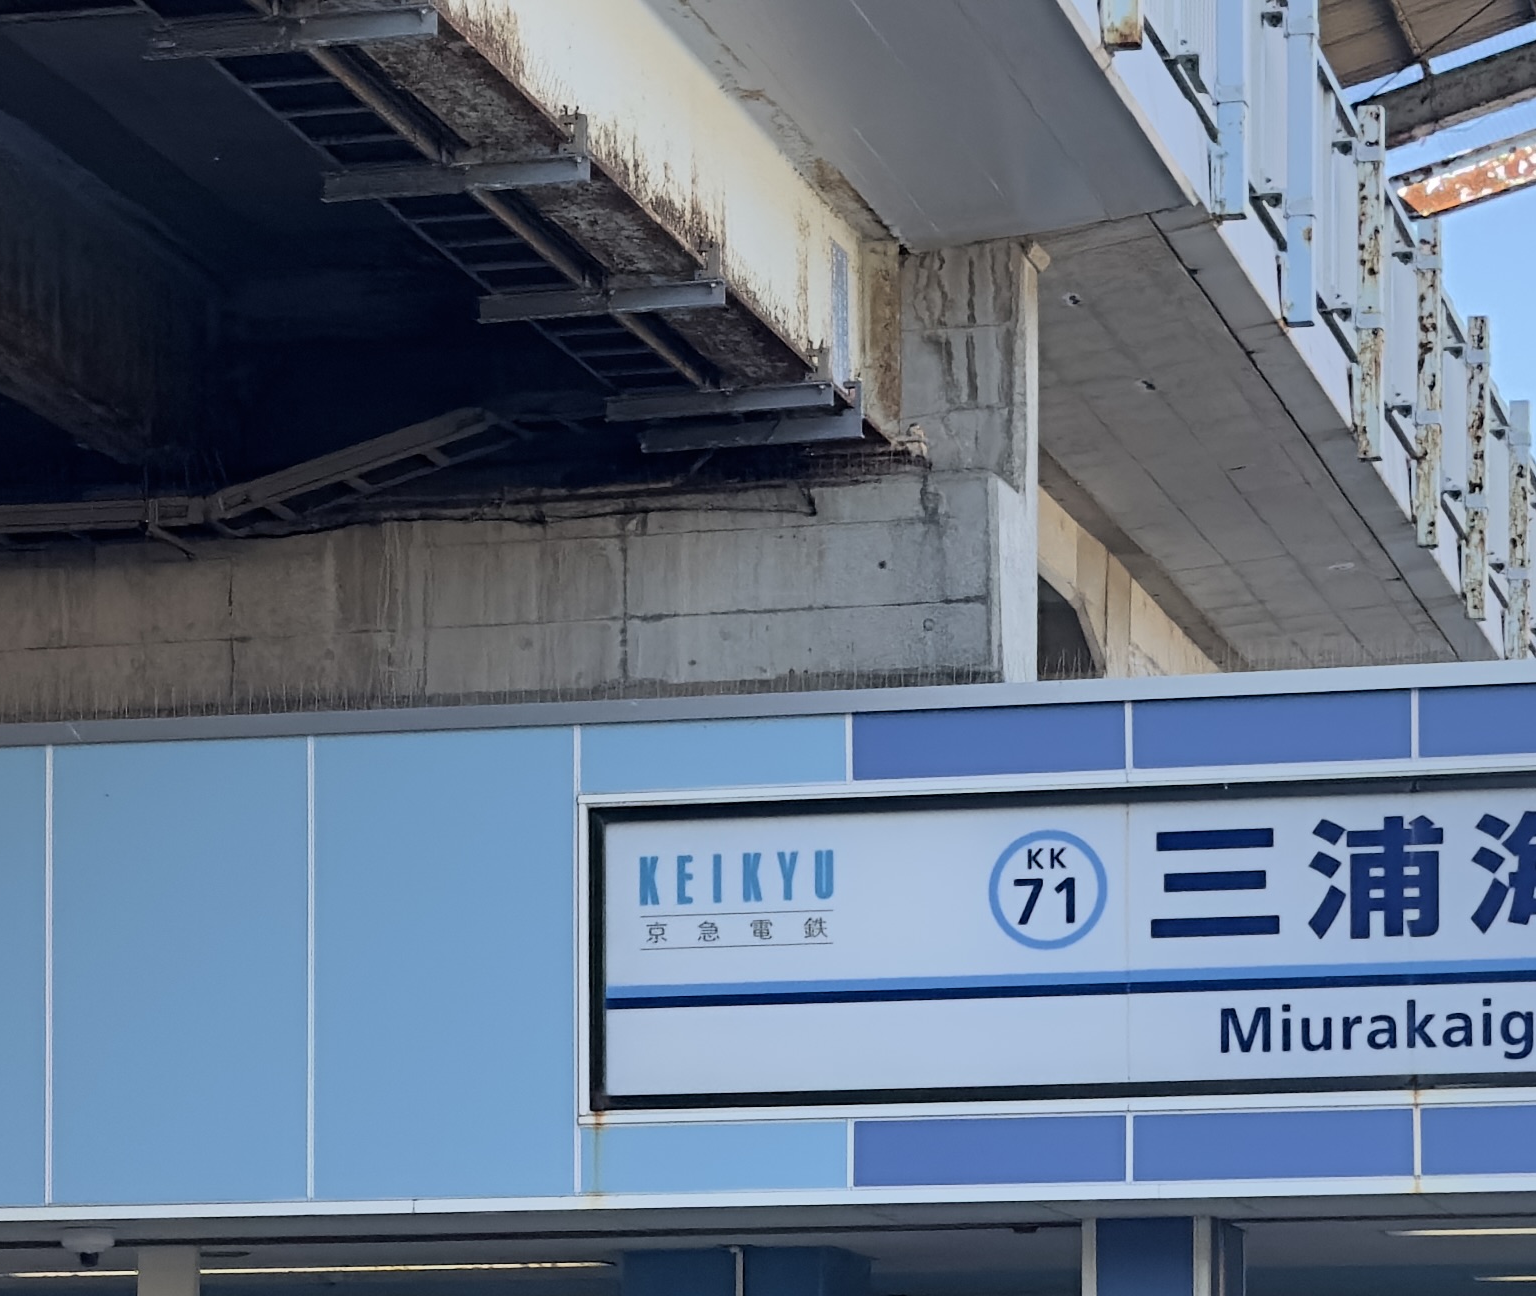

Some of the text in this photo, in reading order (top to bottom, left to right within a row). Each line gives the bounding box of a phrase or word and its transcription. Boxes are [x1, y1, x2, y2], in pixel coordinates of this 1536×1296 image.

[639, 849, 835, 907] KEIKYU
[1026, 846, 1067, 871] KK
[1012, 877, 1077, 926] 71
[645, 915, 829, 945] 京急電鉄
